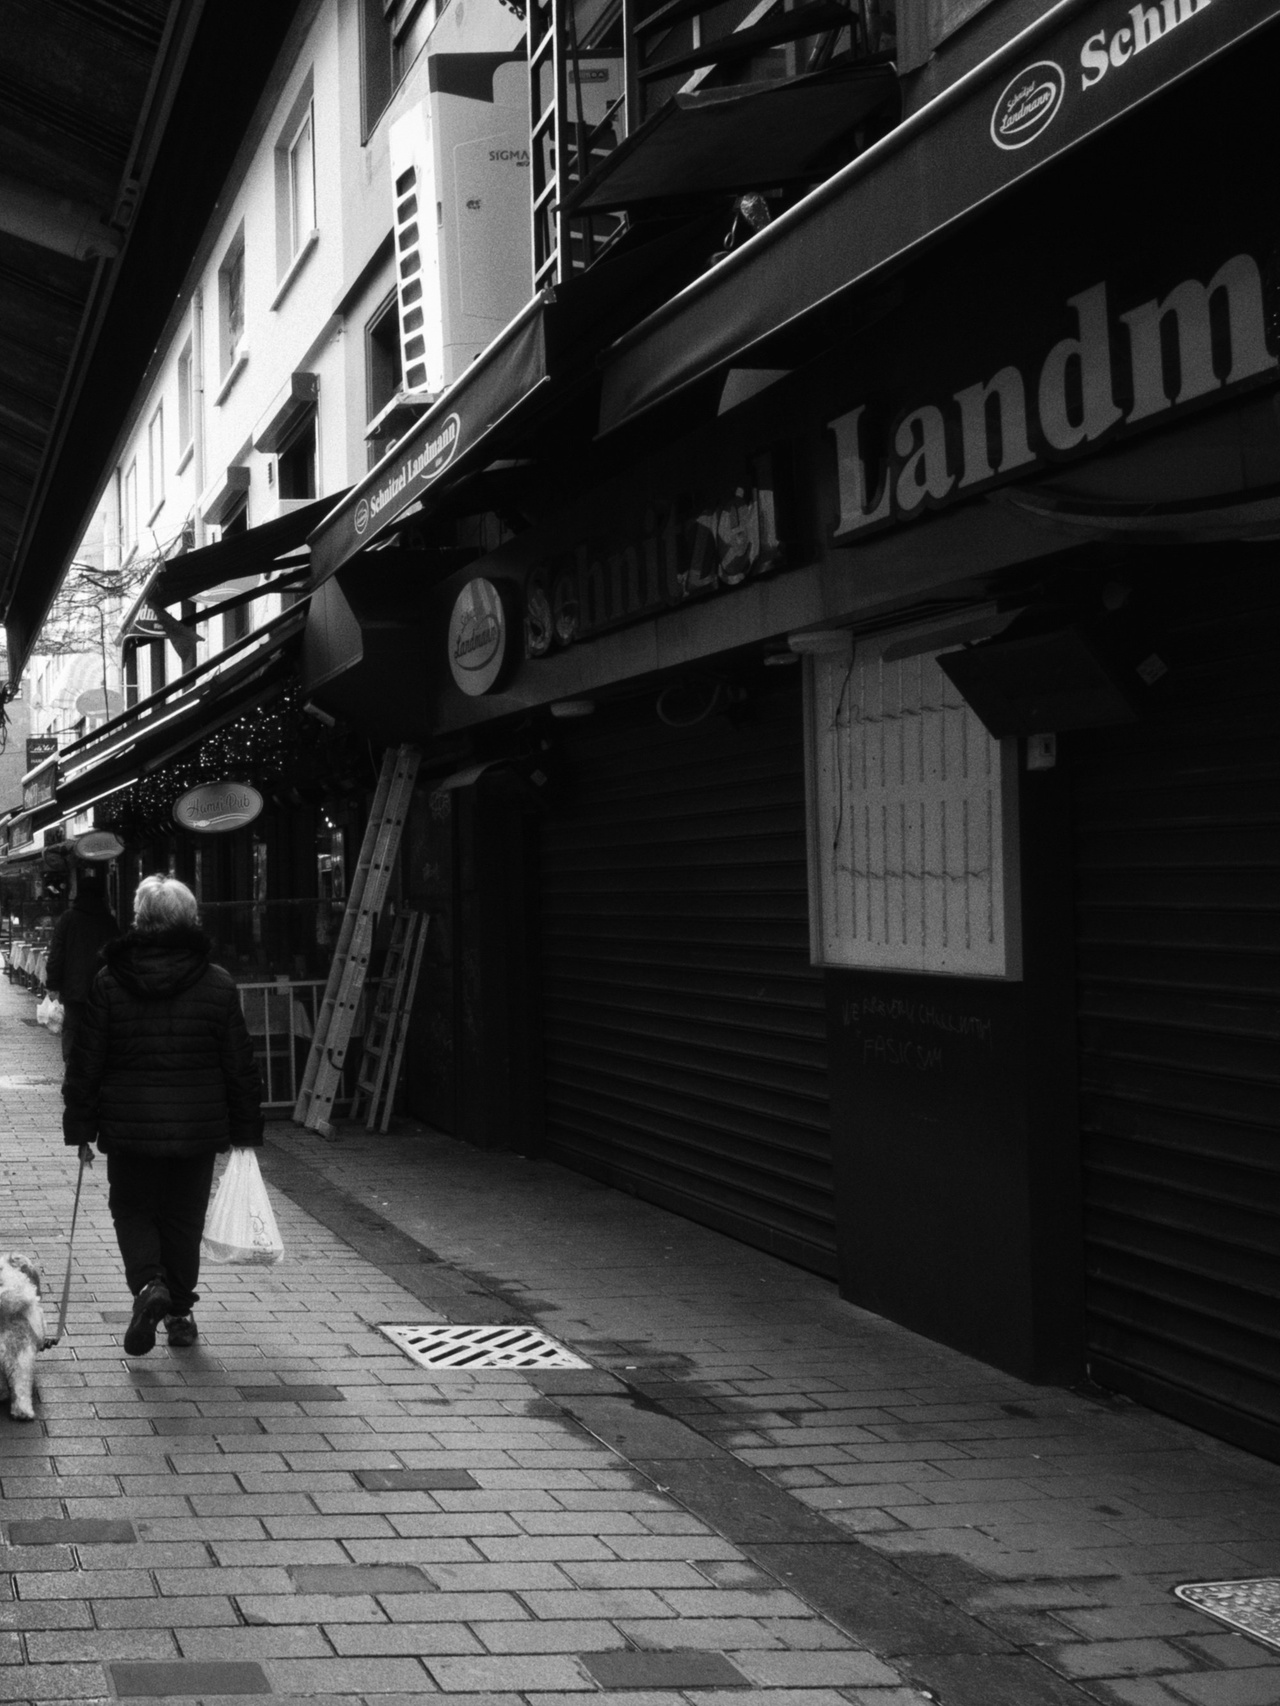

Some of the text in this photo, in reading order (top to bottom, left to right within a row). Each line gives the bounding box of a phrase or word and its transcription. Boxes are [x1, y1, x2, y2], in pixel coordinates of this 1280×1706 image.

[1000, 92, 1051, 131] Landmann
[489, 150, 530, 161] SIGMA
[370, 422, 456, 518] Schnitzel Landmann
[454, 626, 497, 659] Landmann
[225, 792, 251, 809] Pub
